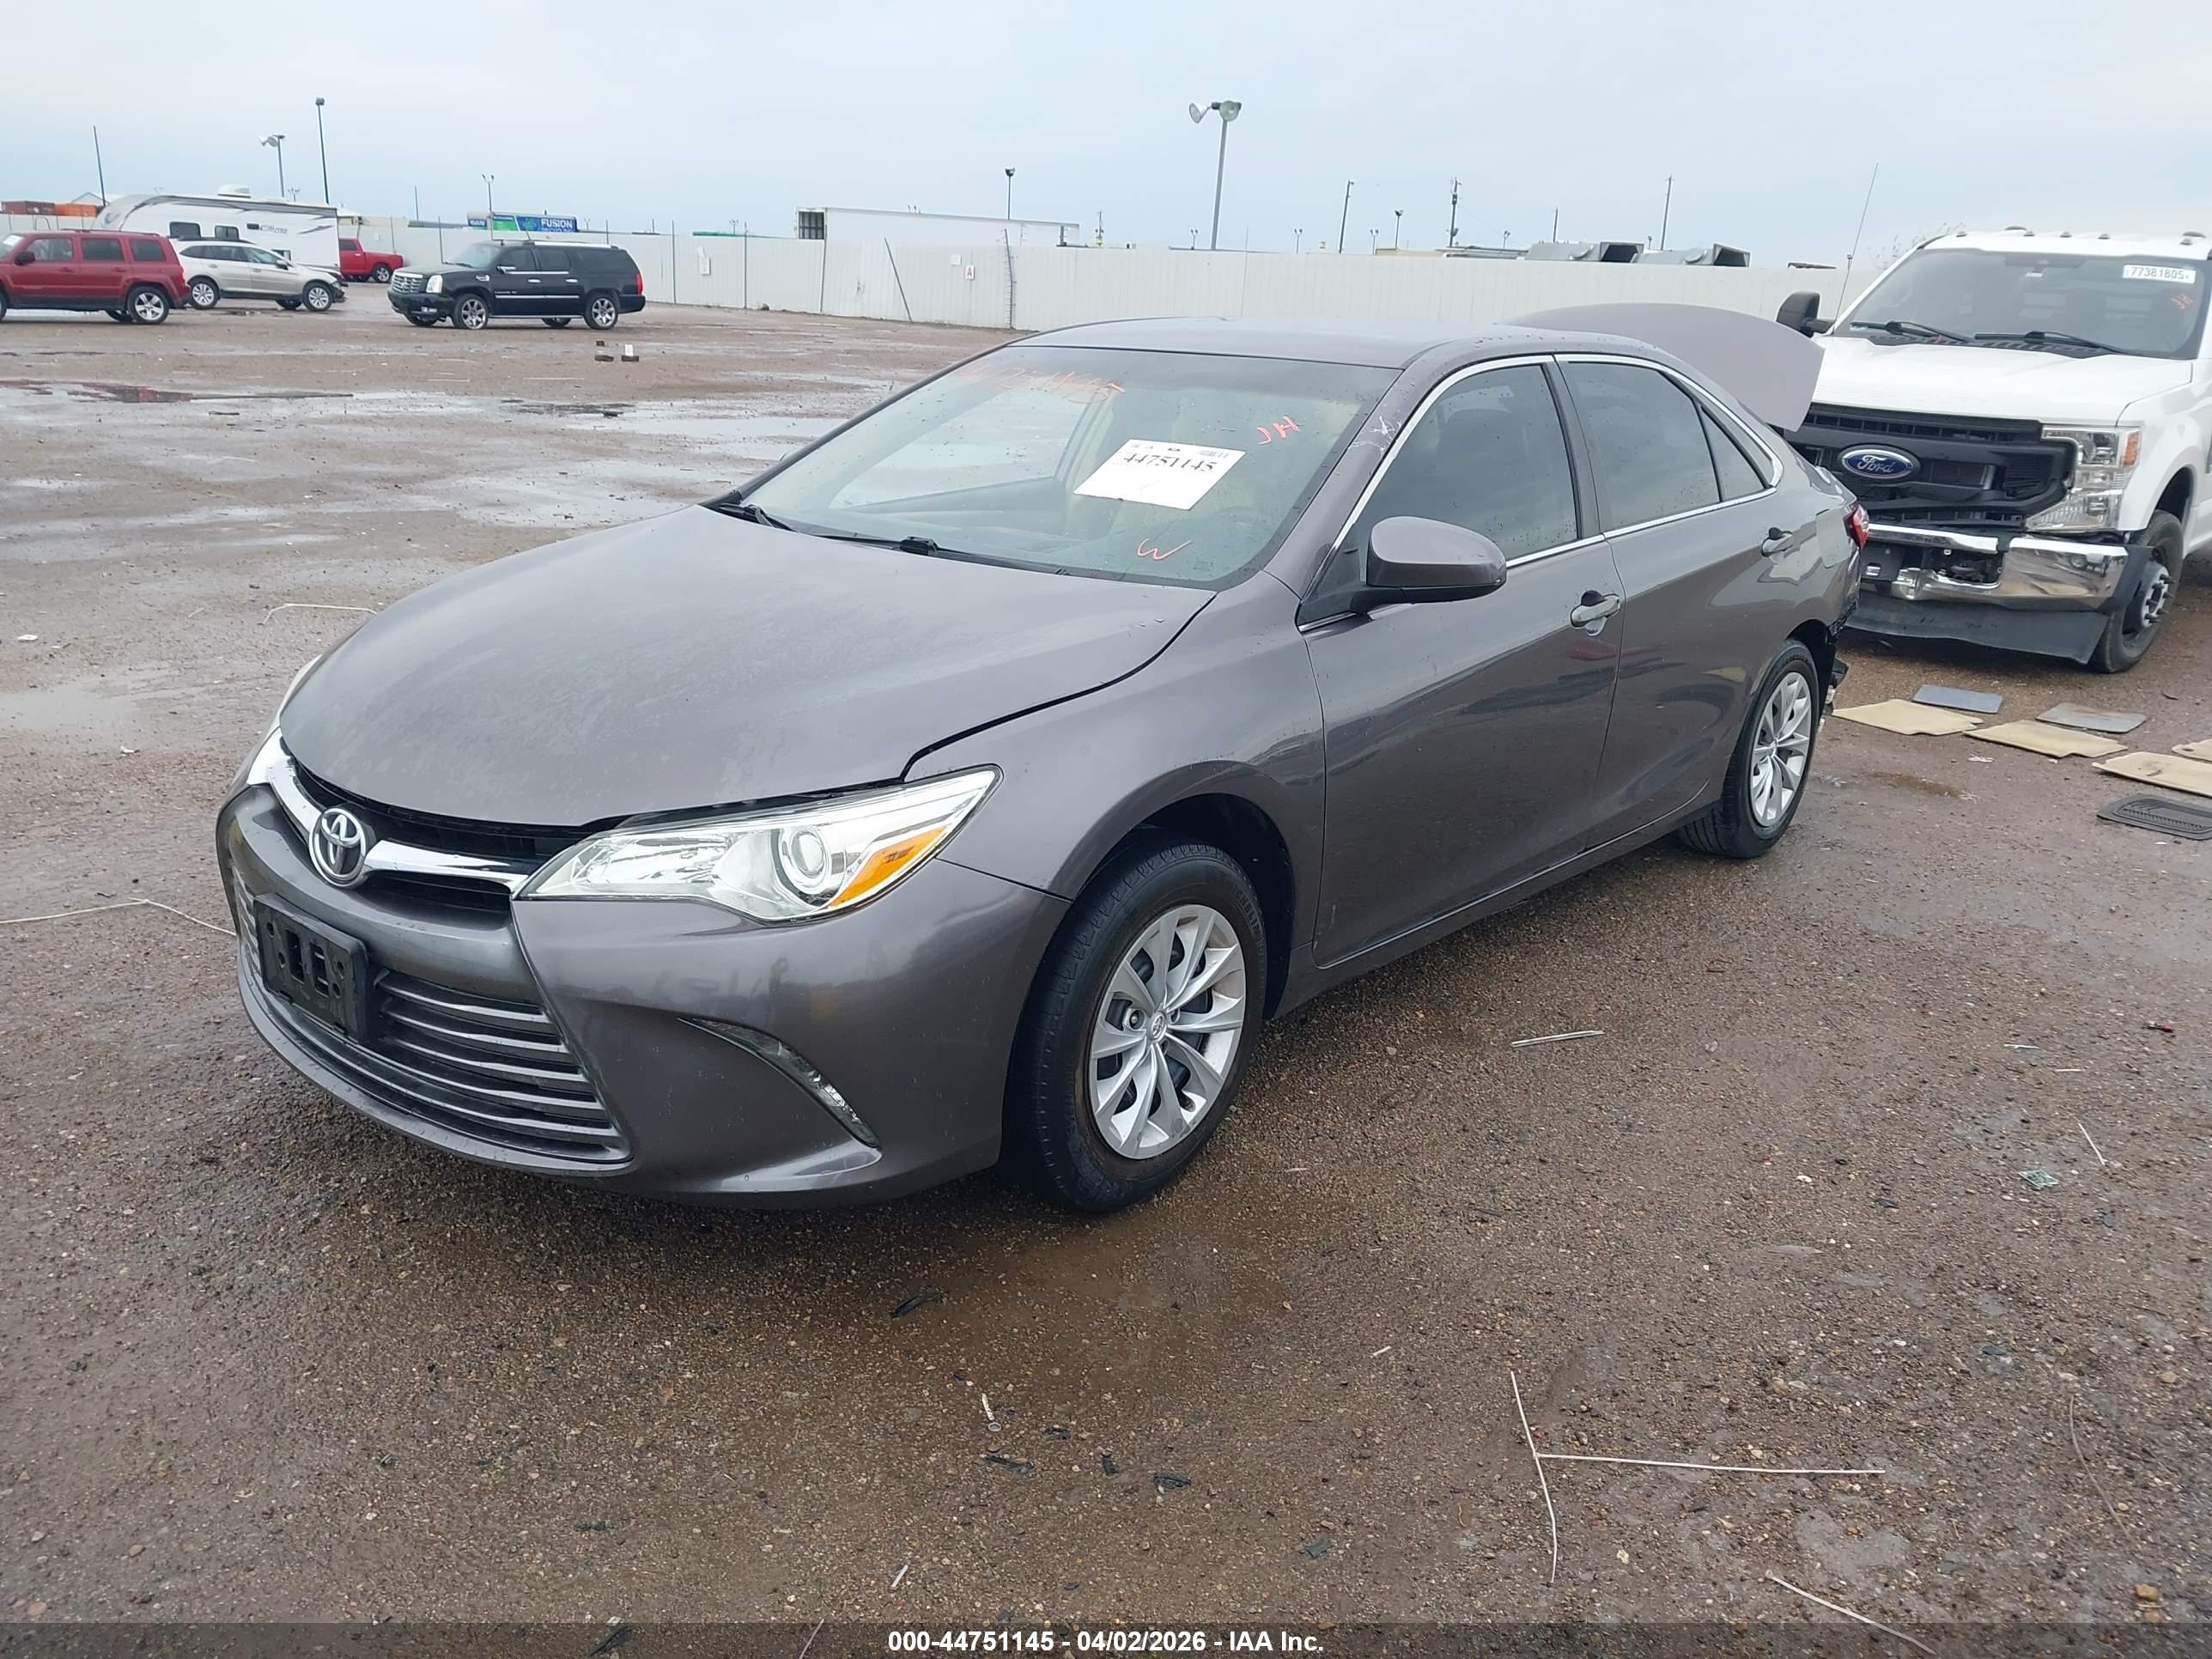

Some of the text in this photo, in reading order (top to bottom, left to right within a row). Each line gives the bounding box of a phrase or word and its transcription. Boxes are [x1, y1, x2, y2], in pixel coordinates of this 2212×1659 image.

[541, 218, 574, 228] FUSION
[2130, 267, 2185, 280] 77381805
[1122, 453, 1218, 472] 44751145
[1857, 454, 1896, 473] Ford
